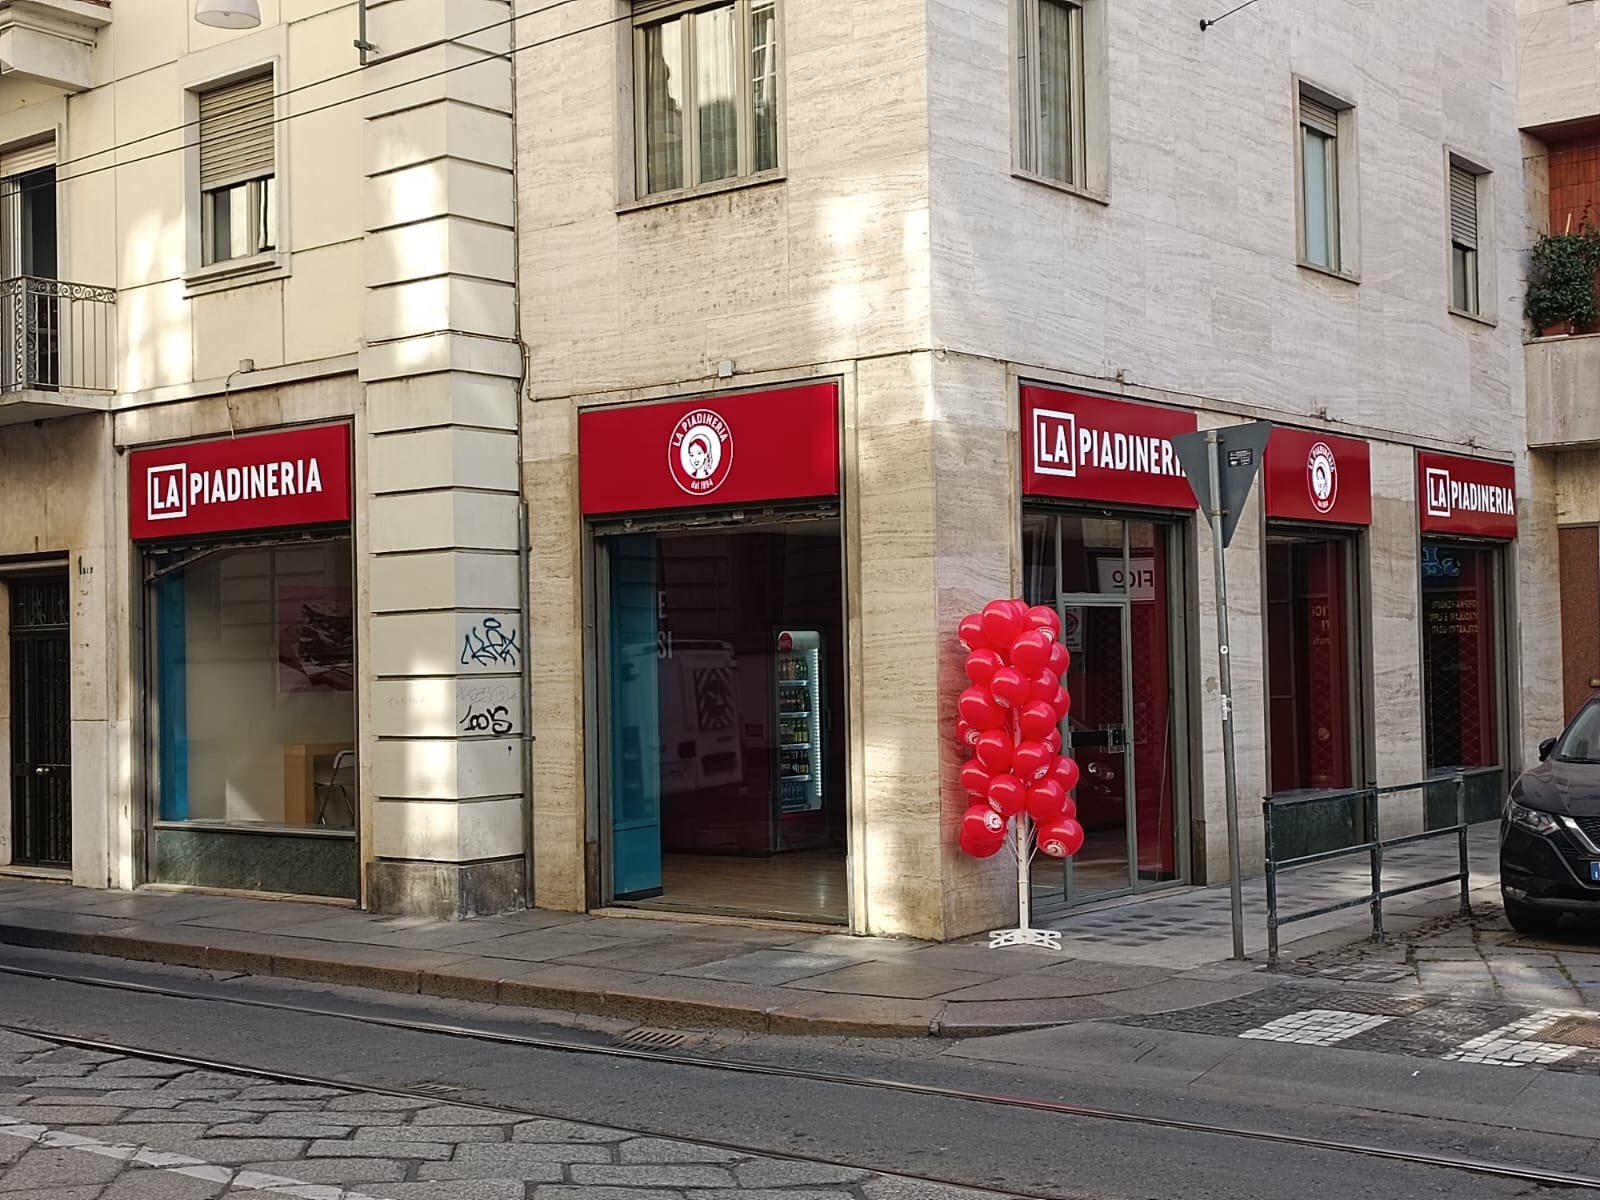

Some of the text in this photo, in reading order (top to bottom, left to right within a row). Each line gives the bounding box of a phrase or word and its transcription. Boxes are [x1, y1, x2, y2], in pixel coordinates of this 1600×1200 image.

[672, 413, 728, 447] LA PIADINERIA
[1040, 422, 1187, 477] LA PIADINERI
[153, 457, 322, 510] LA PIADINERIA
[1430, 477, 1514, 515] LA PIADINERIA
